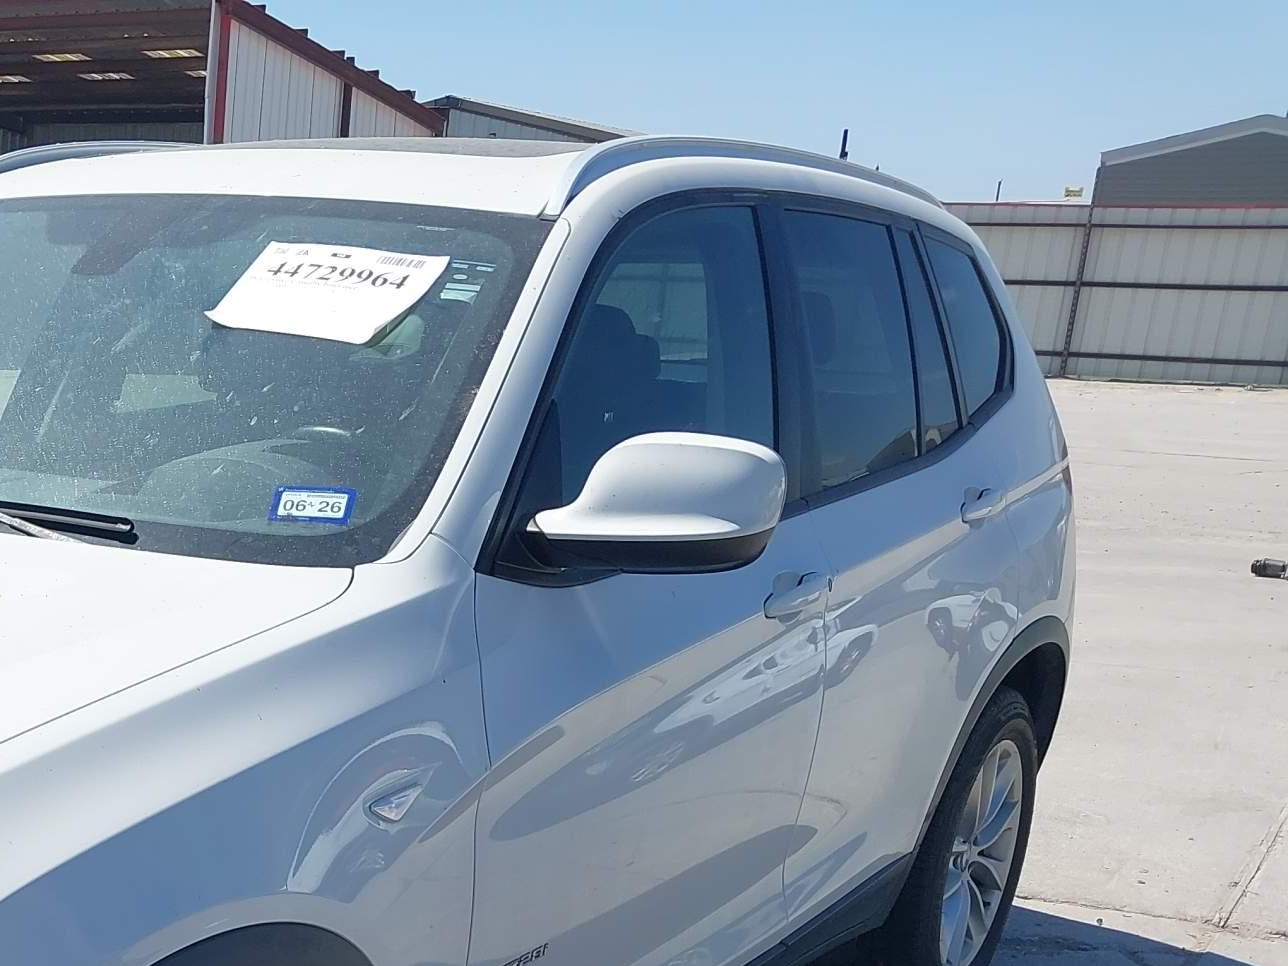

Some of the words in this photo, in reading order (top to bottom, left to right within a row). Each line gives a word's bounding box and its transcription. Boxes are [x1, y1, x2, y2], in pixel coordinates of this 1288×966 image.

[266, 260, 411, 290] 44729964
[282, 499, 308, 512] 06
[317, 500, 343, 514] 26
